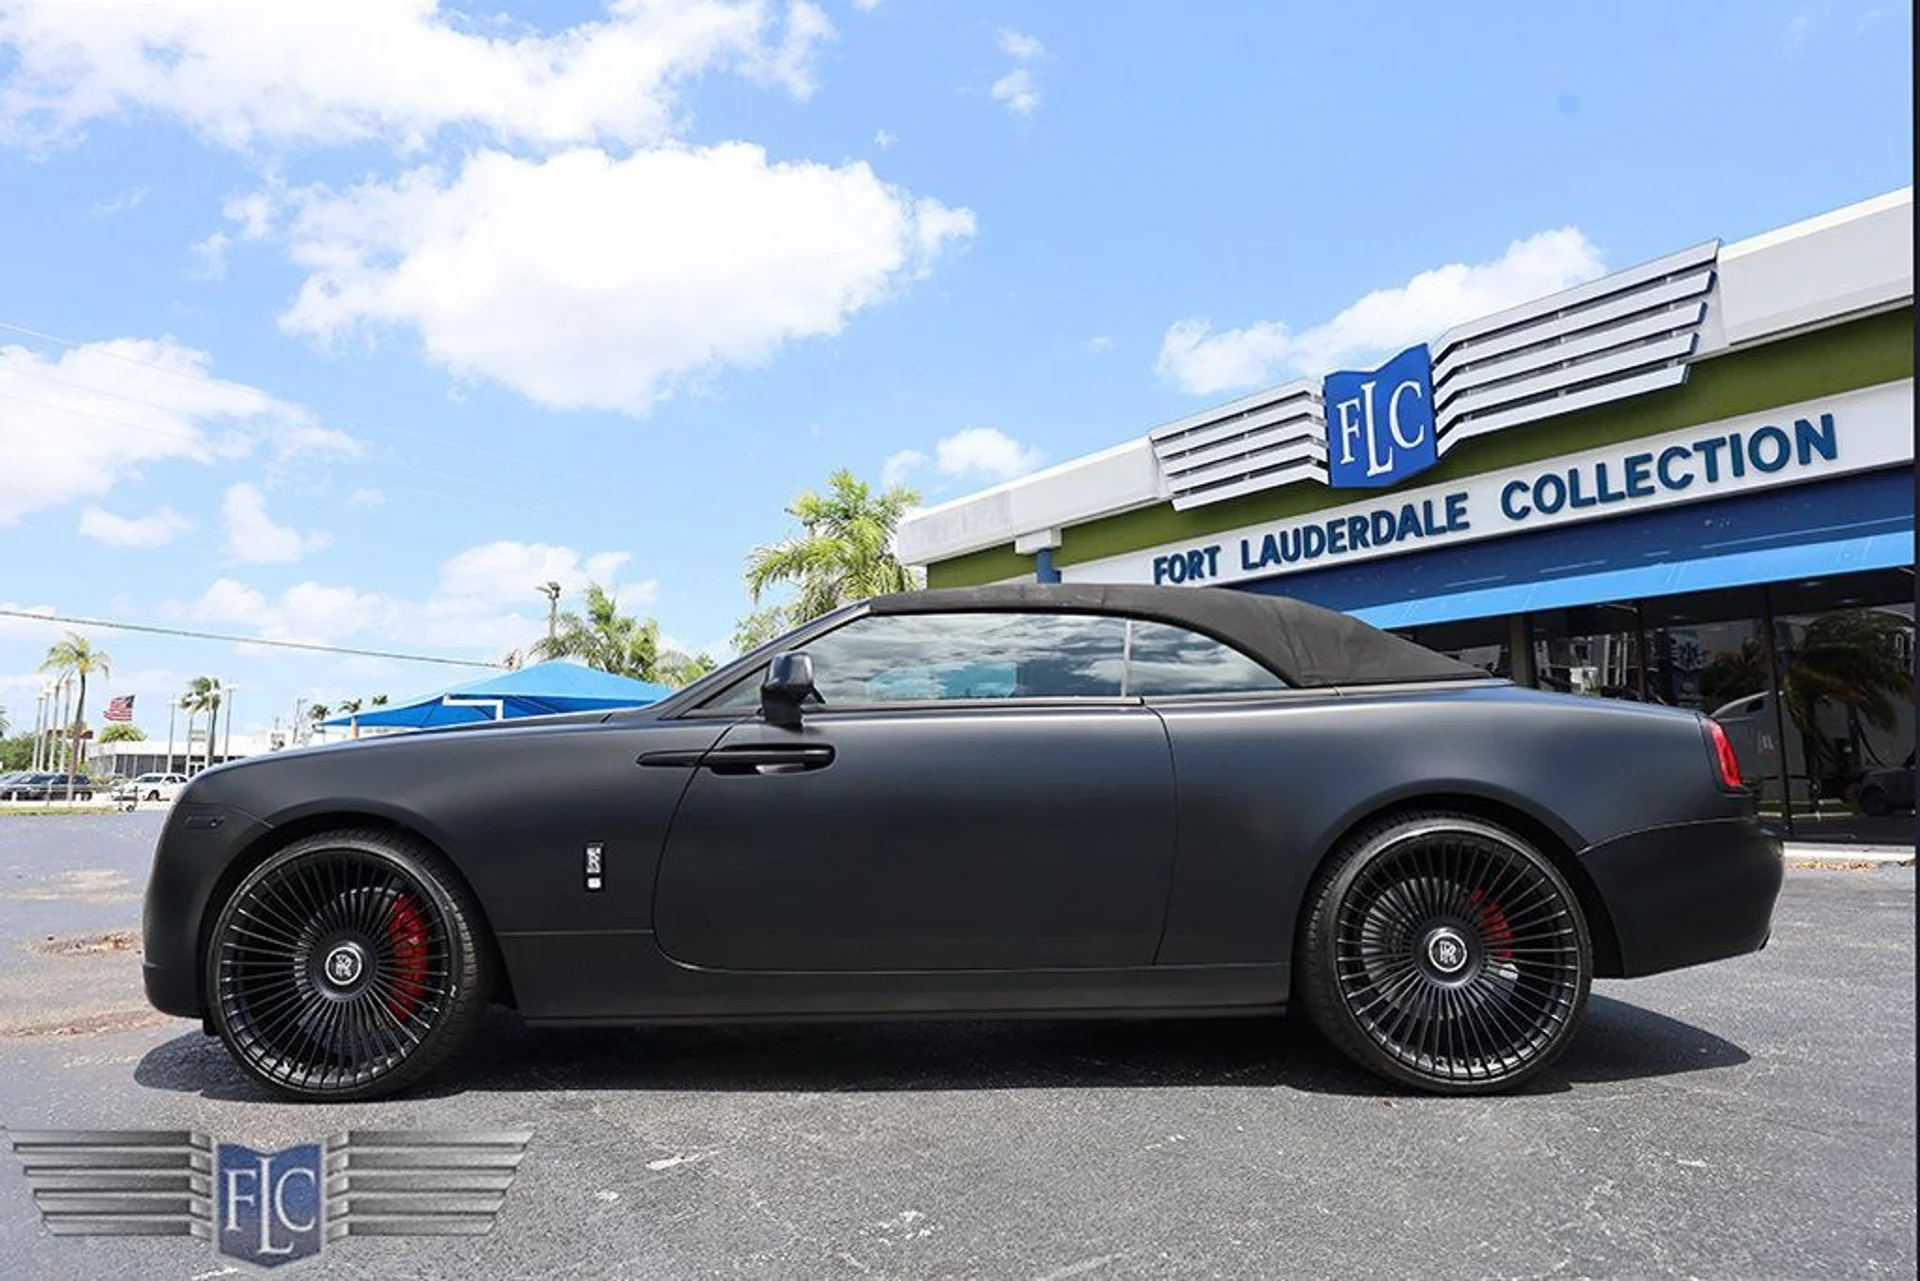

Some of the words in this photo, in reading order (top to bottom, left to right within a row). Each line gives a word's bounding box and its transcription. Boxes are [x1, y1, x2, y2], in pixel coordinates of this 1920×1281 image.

[1336, 380, 1425, 477] FLC
[1153, 545, 1221, 585] FORT
[1241, 492, 1471, 571] LAUDERDALE
[1500, 413, 1838, 521] COLLECTION
